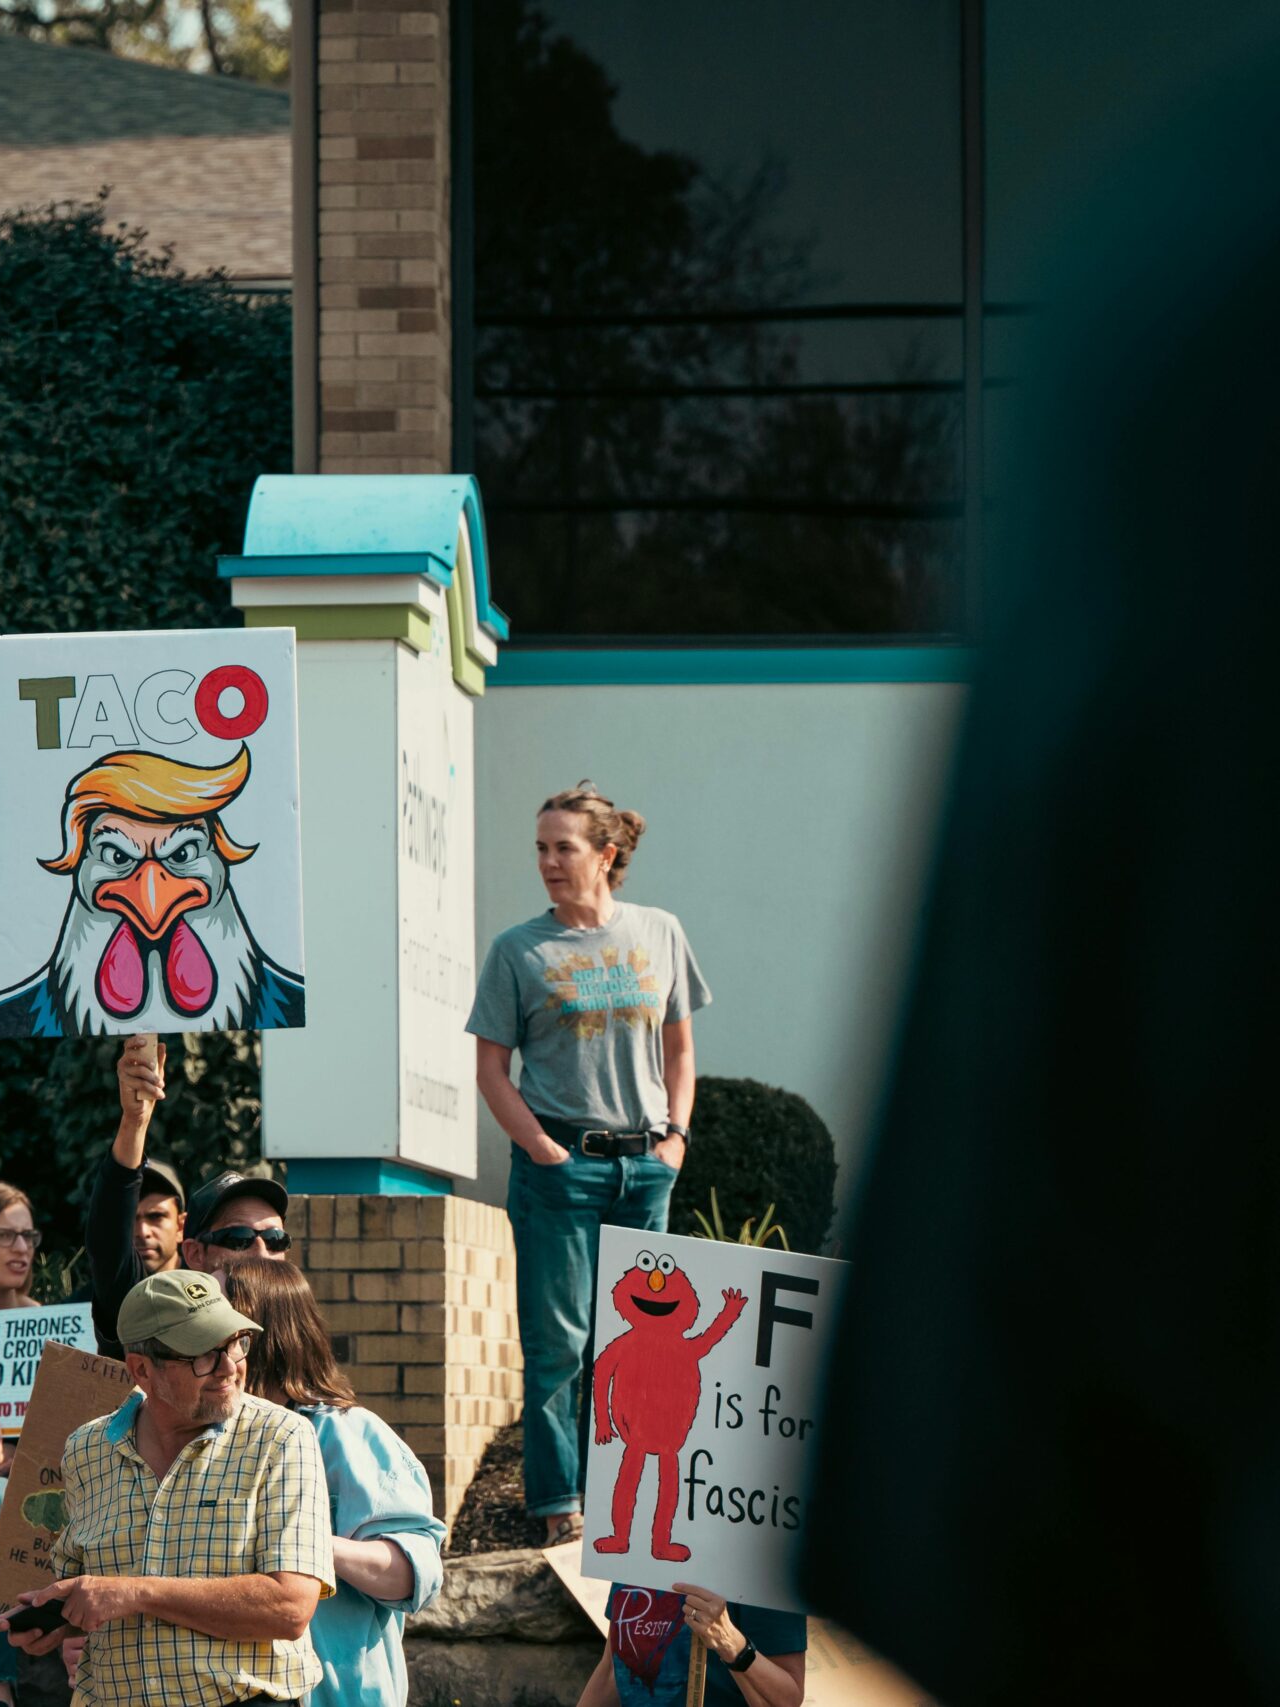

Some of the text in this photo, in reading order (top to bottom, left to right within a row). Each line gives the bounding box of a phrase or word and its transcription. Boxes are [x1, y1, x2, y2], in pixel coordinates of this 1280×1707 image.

[18, 664, 269, 750] TACO
[571, 964, 637, 982] NOT ALL
[577, 977, 639, 996] HEROES
[561, 991, 659, 1015] WEAR CAPES
[5, 1315, 85, 1338] THRONES.
[755, 1270, 819, 1368] F
[81, 1356, 135, 1385] SCIEN
[714, 1381, 814, 1440] is for
[9, 1547, 28, 1564] HE
[615, 1588, 672, 1659] RESIST!
